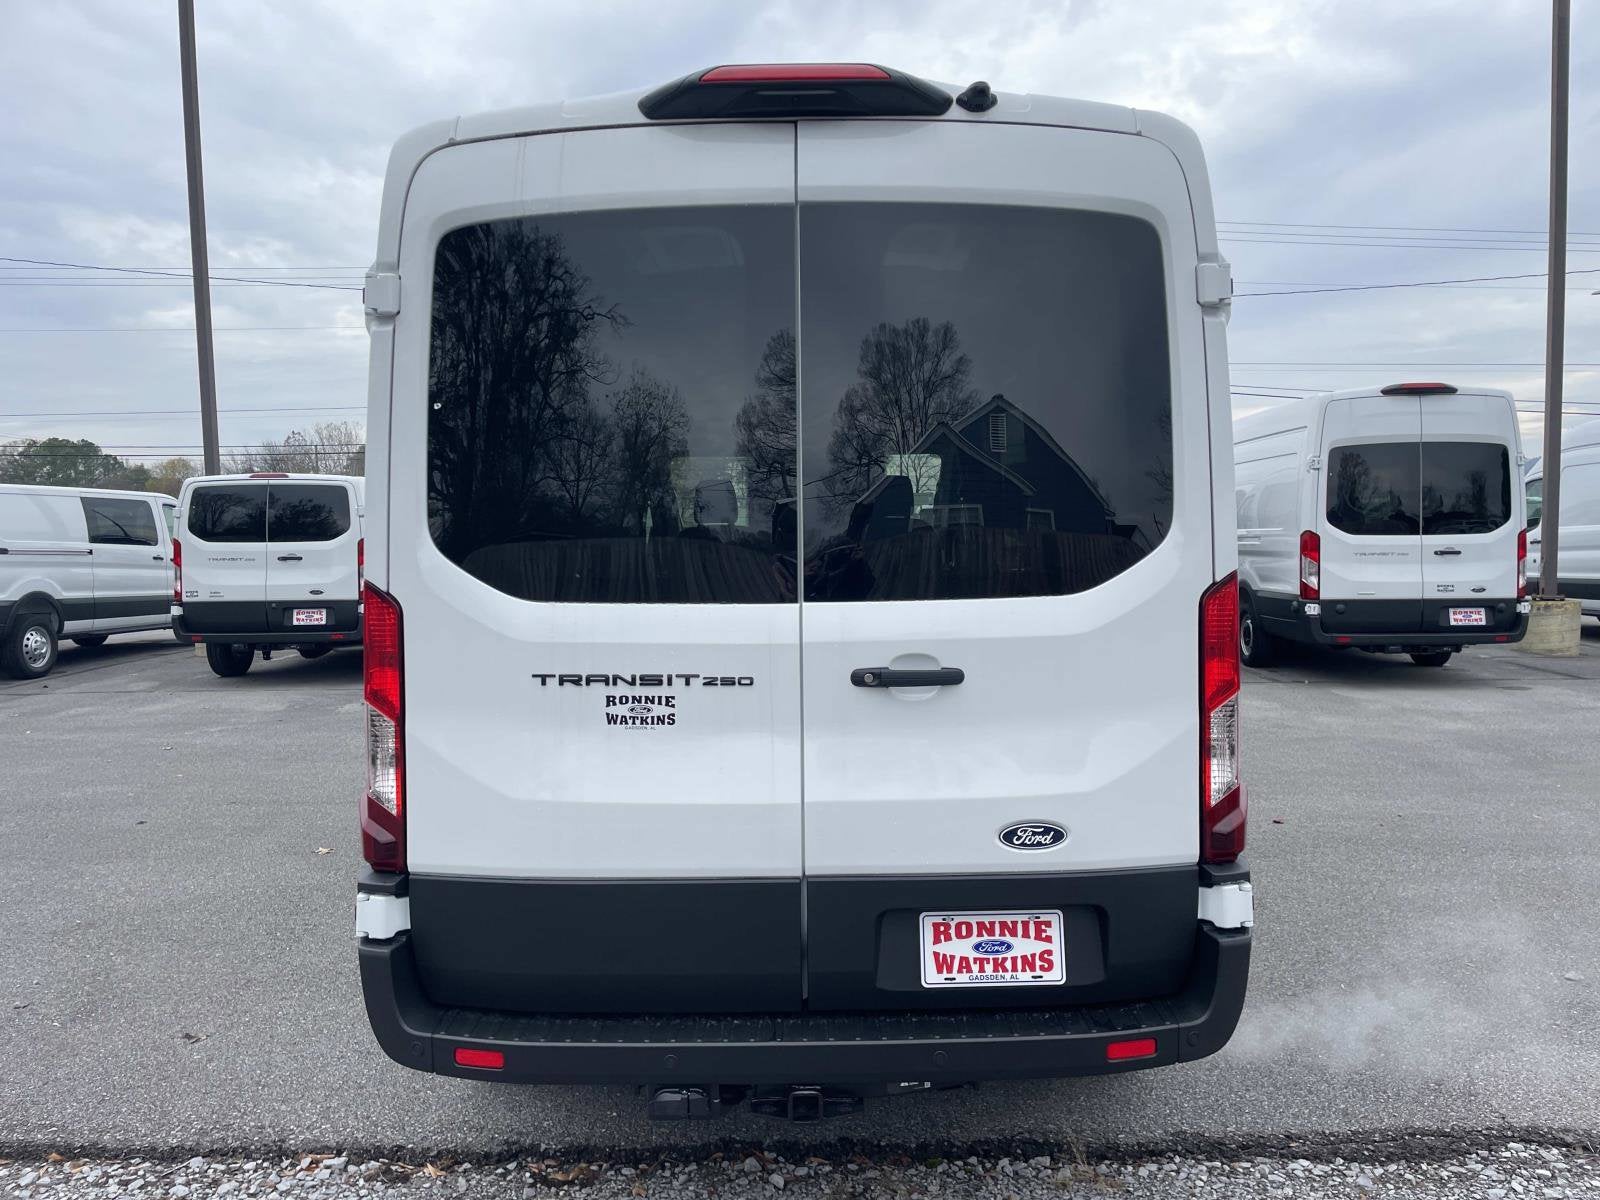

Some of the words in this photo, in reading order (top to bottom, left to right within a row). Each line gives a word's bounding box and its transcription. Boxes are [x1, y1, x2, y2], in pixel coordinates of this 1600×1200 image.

[532, 674, 700, 686] TRANSIT
[703, 677, 754, 686] 250
[605, 695, 676, 709] RONNIE
[605, 712, 676, 726] WATKINS
[1013, 827, 1054, 845] Ford
[932, 921, 1053, 945] RONNIE
[978, 941, 1008, 953] Ford
[932, 949, 1055, 975] WATKINS
[968, 974, 1008, 982] GADSDEN,
[1009, 973, 1020, 981] AL
